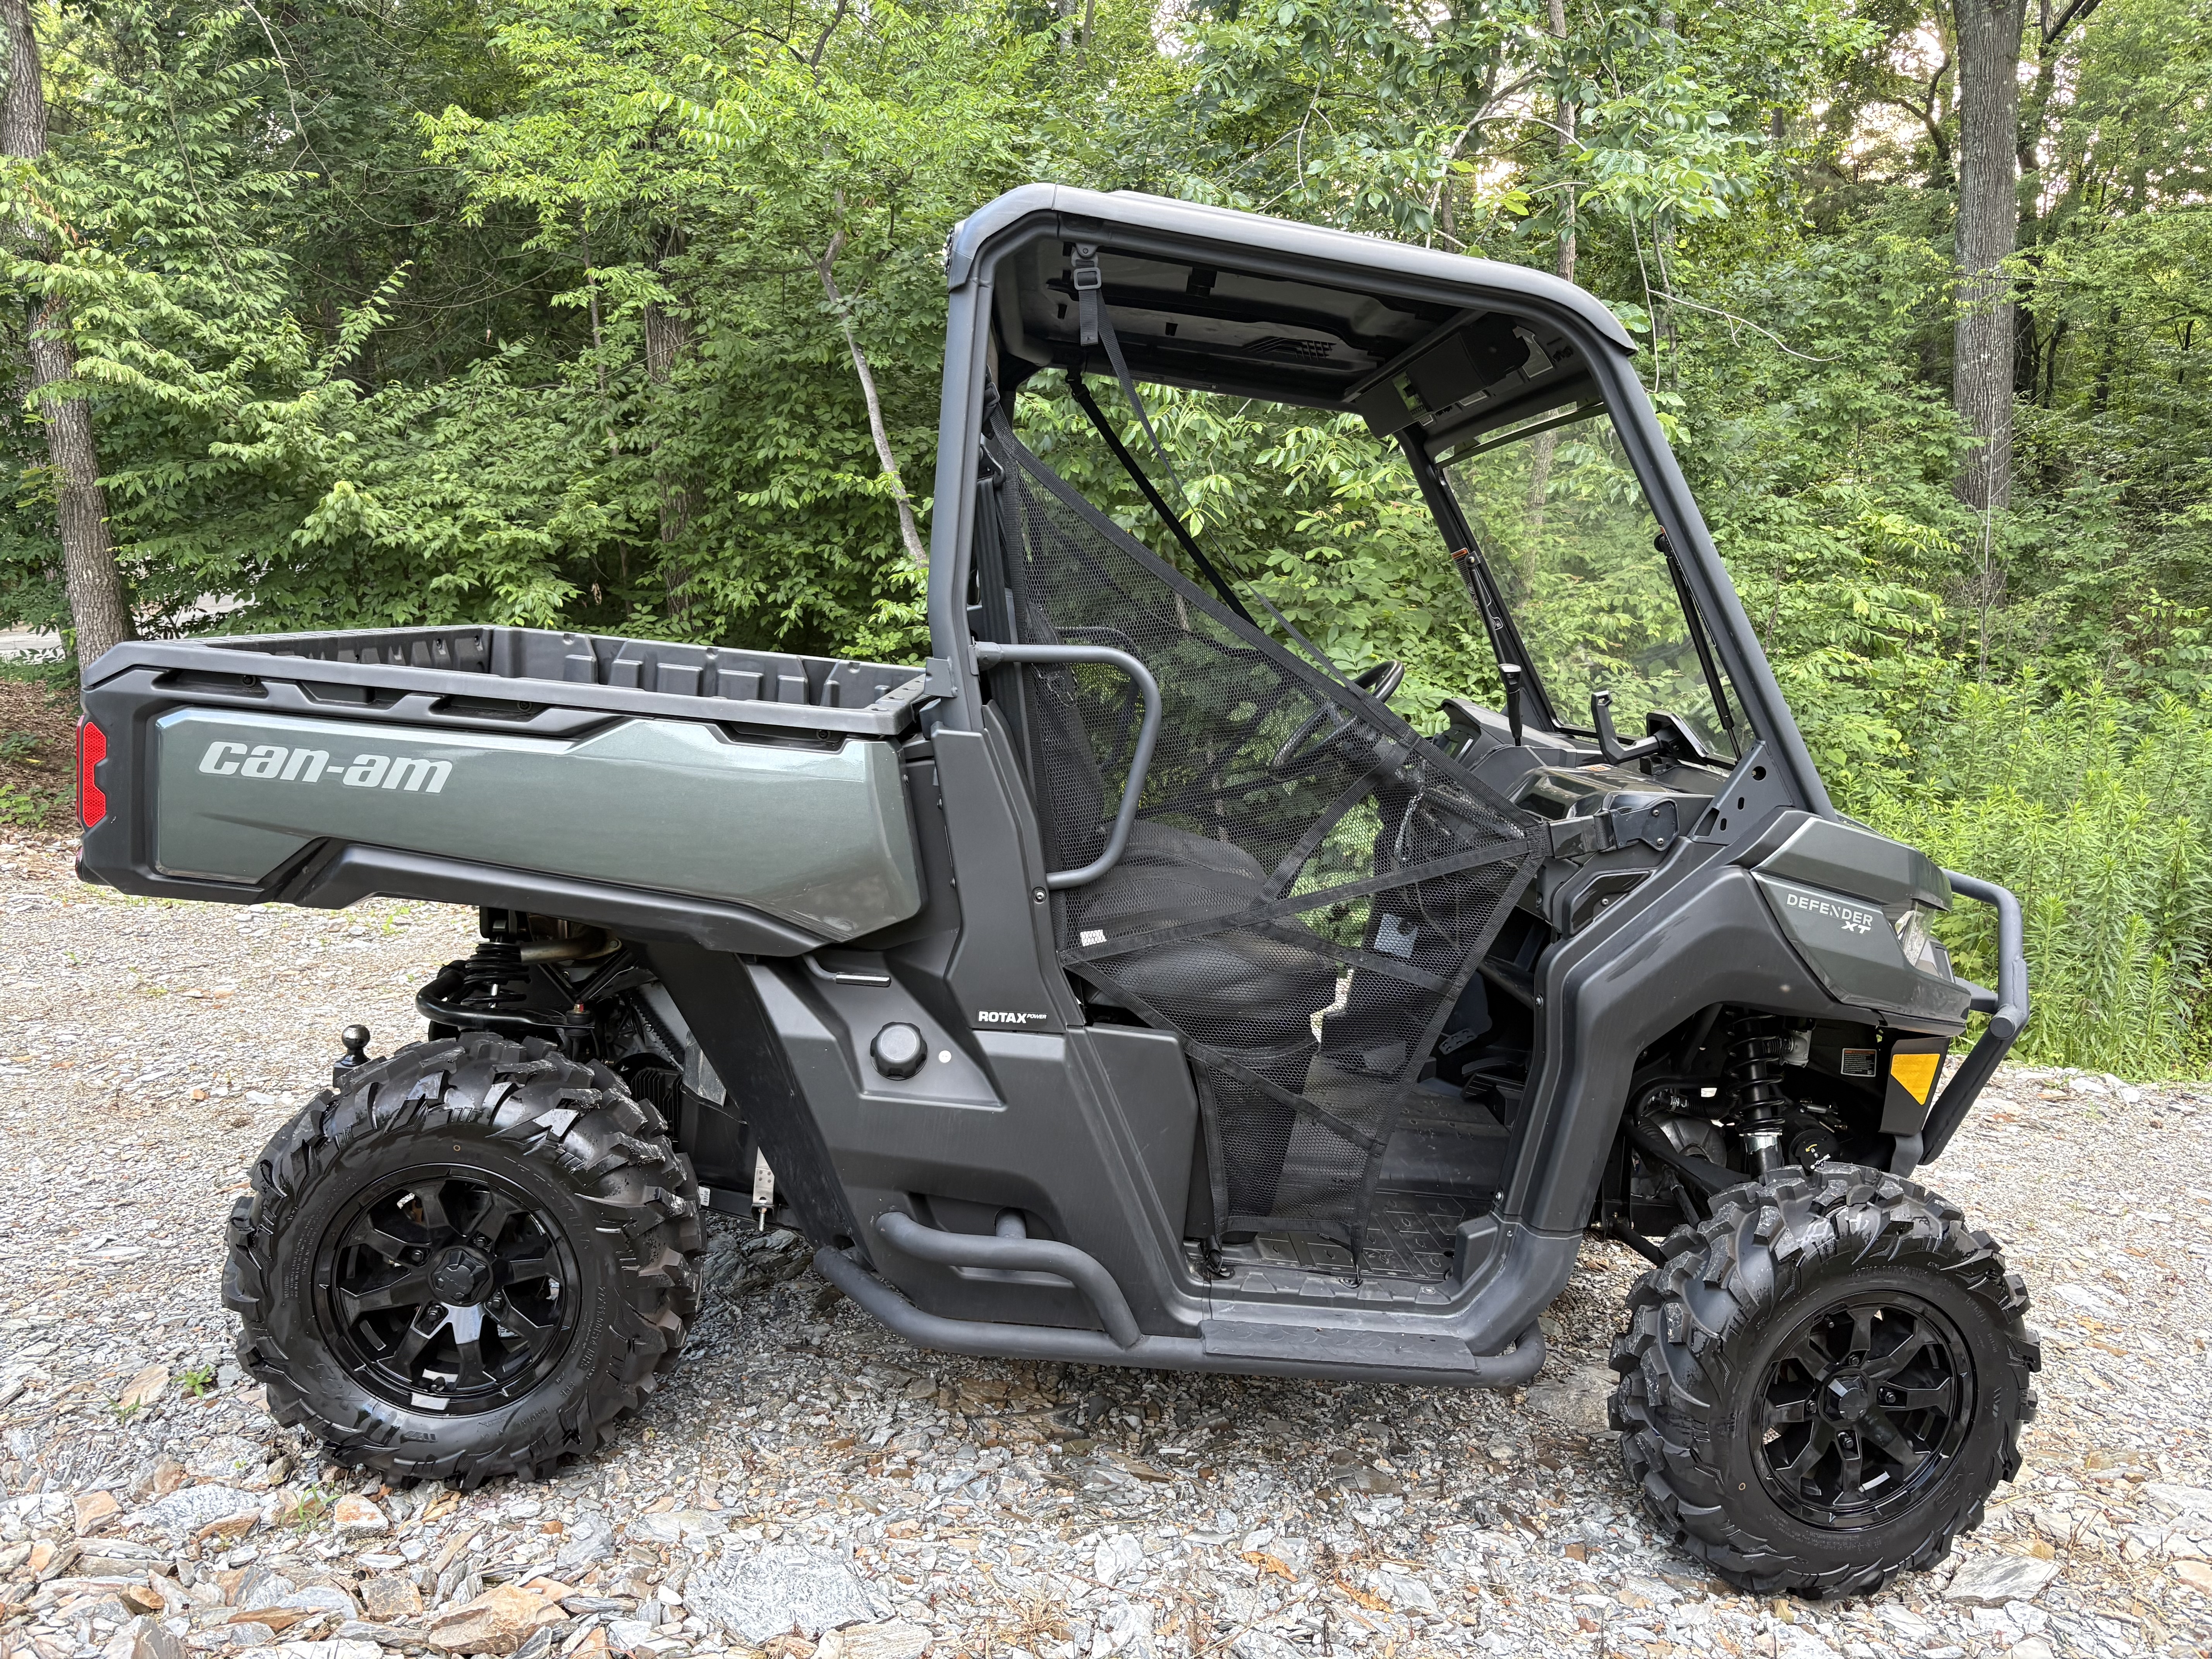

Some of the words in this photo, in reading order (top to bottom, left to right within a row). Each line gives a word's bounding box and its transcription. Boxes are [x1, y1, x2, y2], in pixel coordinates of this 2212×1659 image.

[1786, 893, 1873, 926] DEFENDER
[1841, 921, 1871, 934] XT
[978, 1011, 1027, 1024] ROTAX
